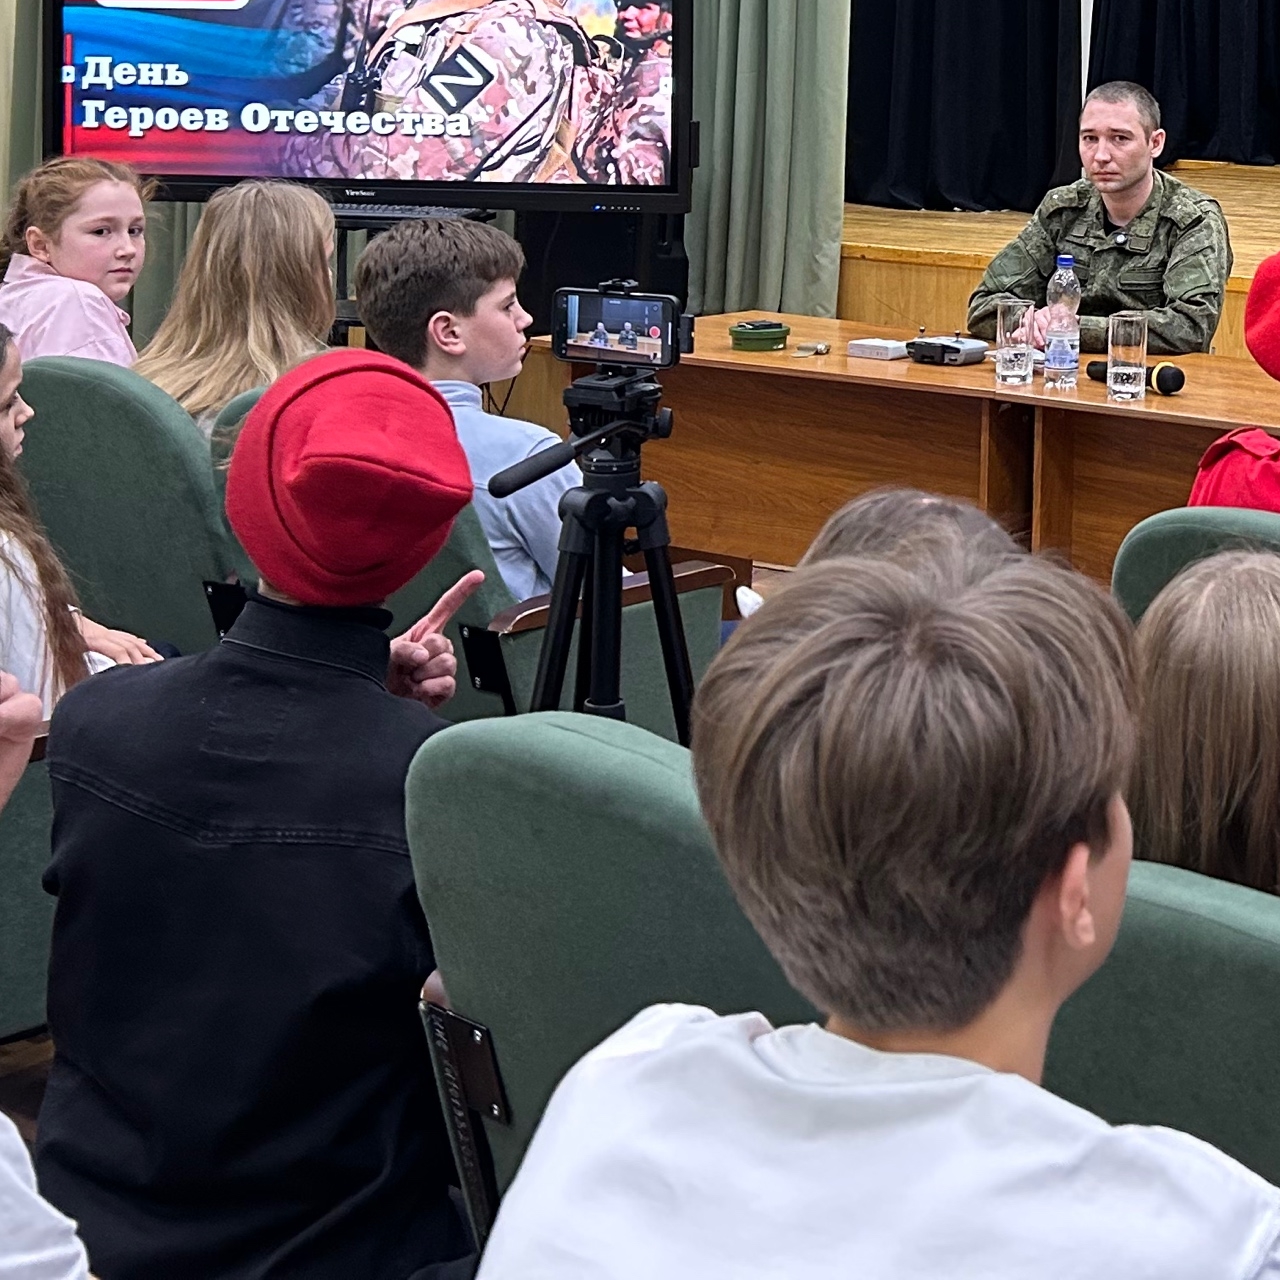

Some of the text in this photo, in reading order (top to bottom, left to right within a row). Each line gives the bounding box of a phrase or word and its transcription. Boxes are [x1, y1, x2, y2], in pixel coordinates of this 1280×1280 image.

[81, 56, 189, 90] День
[81, 99, 471, 137] Героев Отечества
